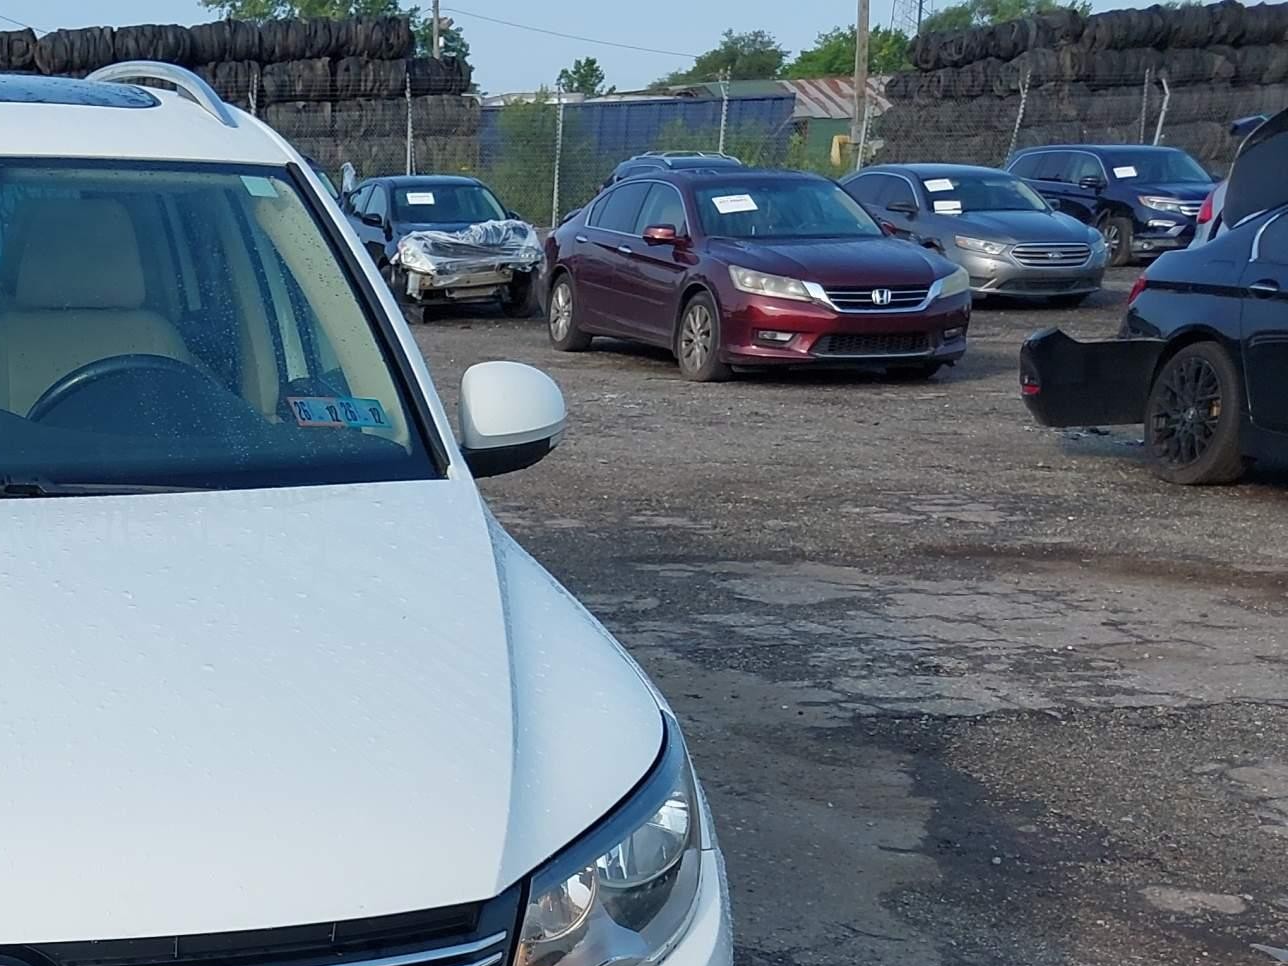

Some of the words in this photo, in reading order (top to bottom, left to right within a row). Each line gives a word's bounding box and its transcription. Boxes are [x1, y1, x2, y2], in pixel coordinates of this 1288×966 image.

[294, 401, 312, 421] 26
[326, 405, 342, 422] 12
[340, 402, 358, 422] 26
[369, 407, 384, 424] 12
